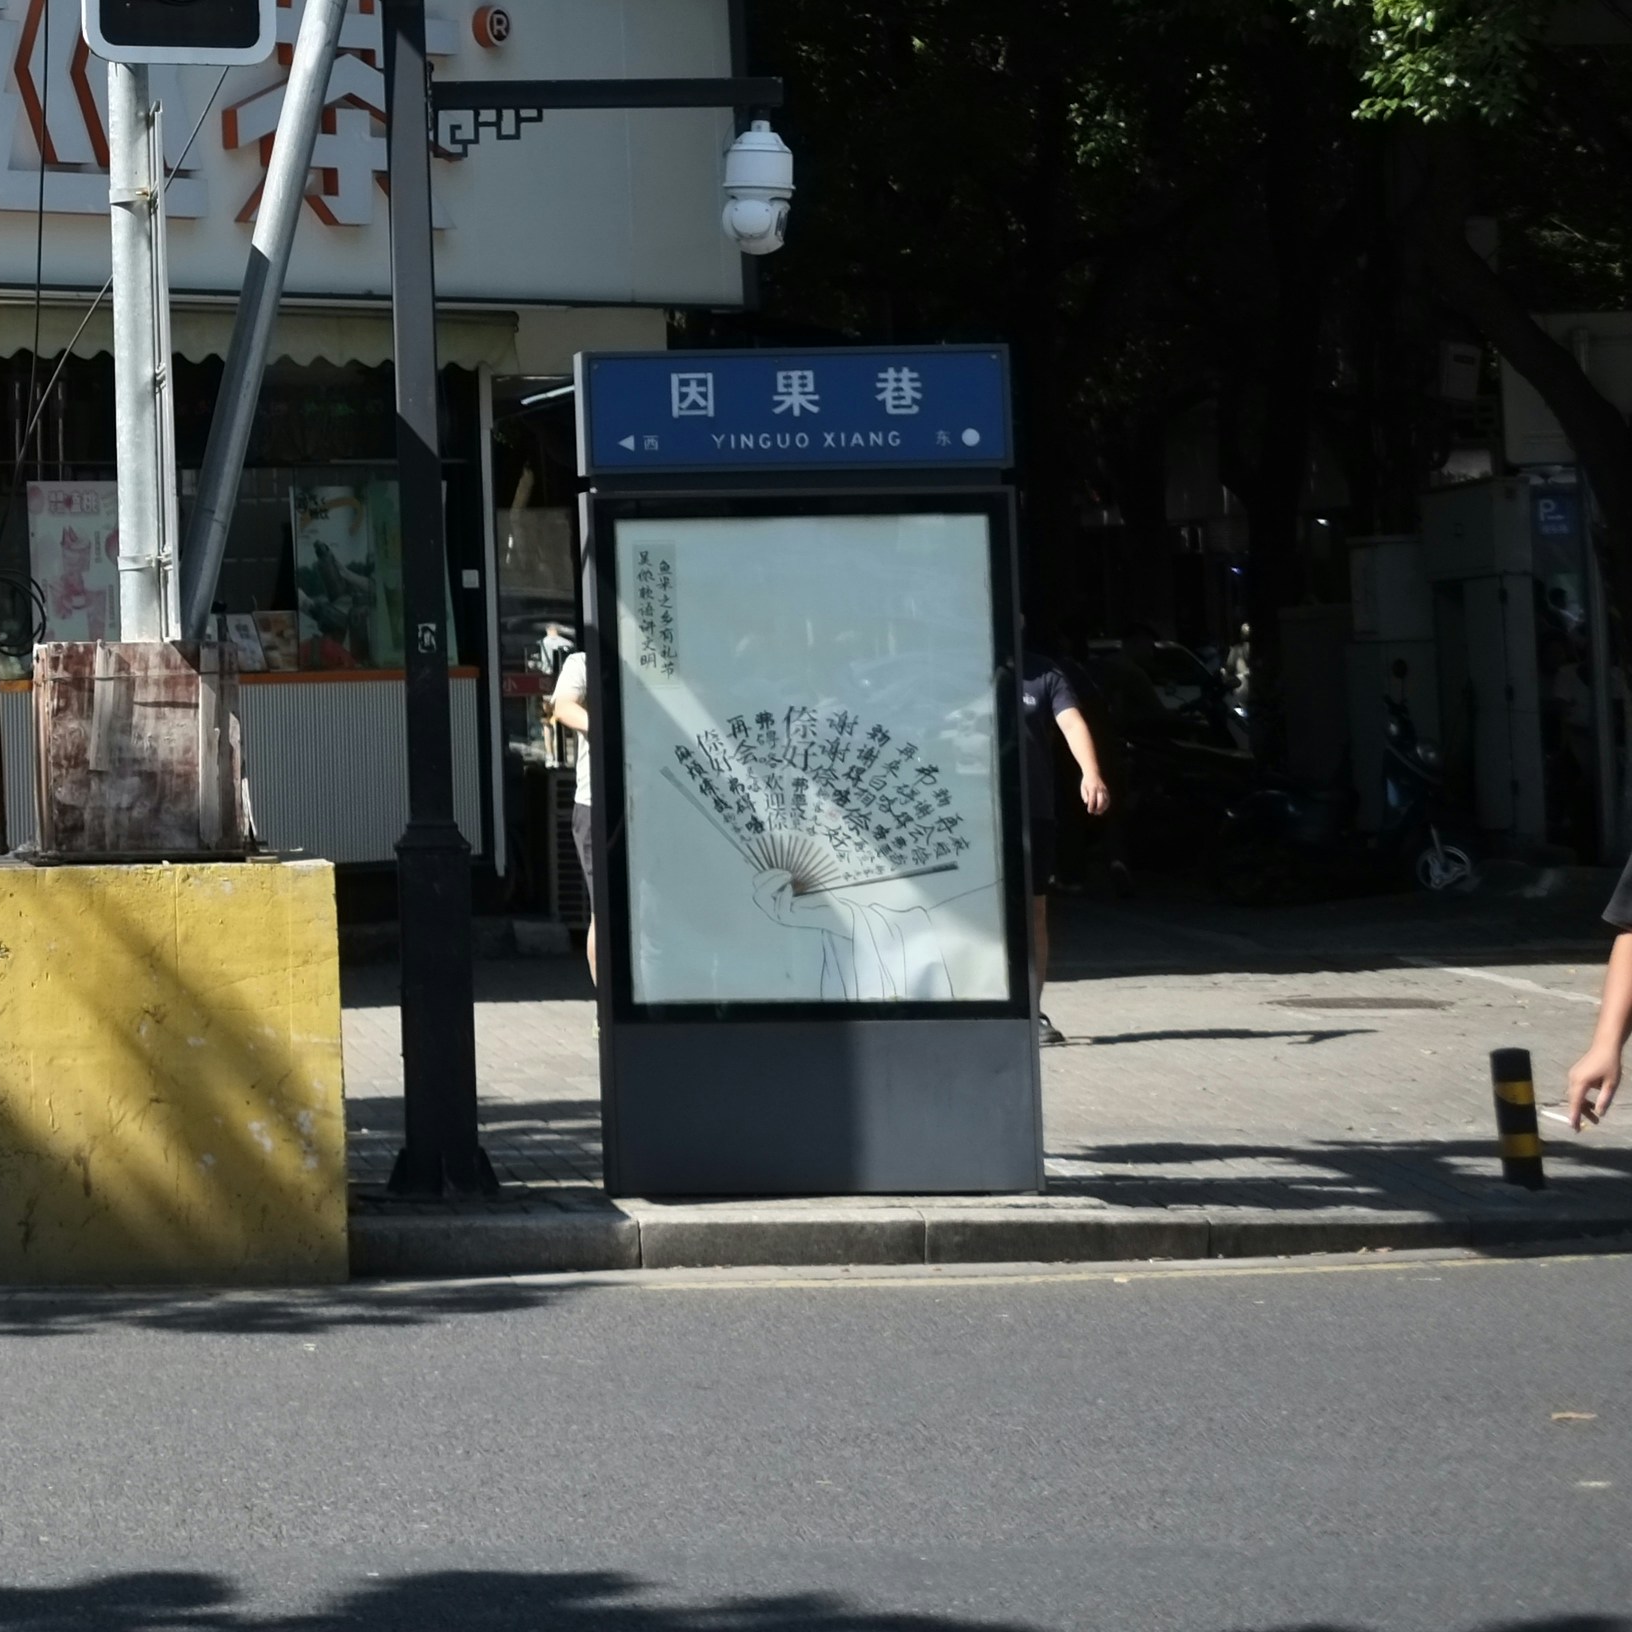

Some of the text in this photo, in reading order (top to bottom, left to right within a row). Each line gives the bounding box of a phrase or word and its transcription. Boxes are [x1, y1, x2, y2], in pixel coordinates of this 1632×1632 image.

[670, 366, 923, 418] 因果巷
[643, 435, 659, 451] 西
[711, 430, 901, 450] YINGUO XIANG
[936, 430, 951, 446] 东
[1539, 499, 1556, 521] P
